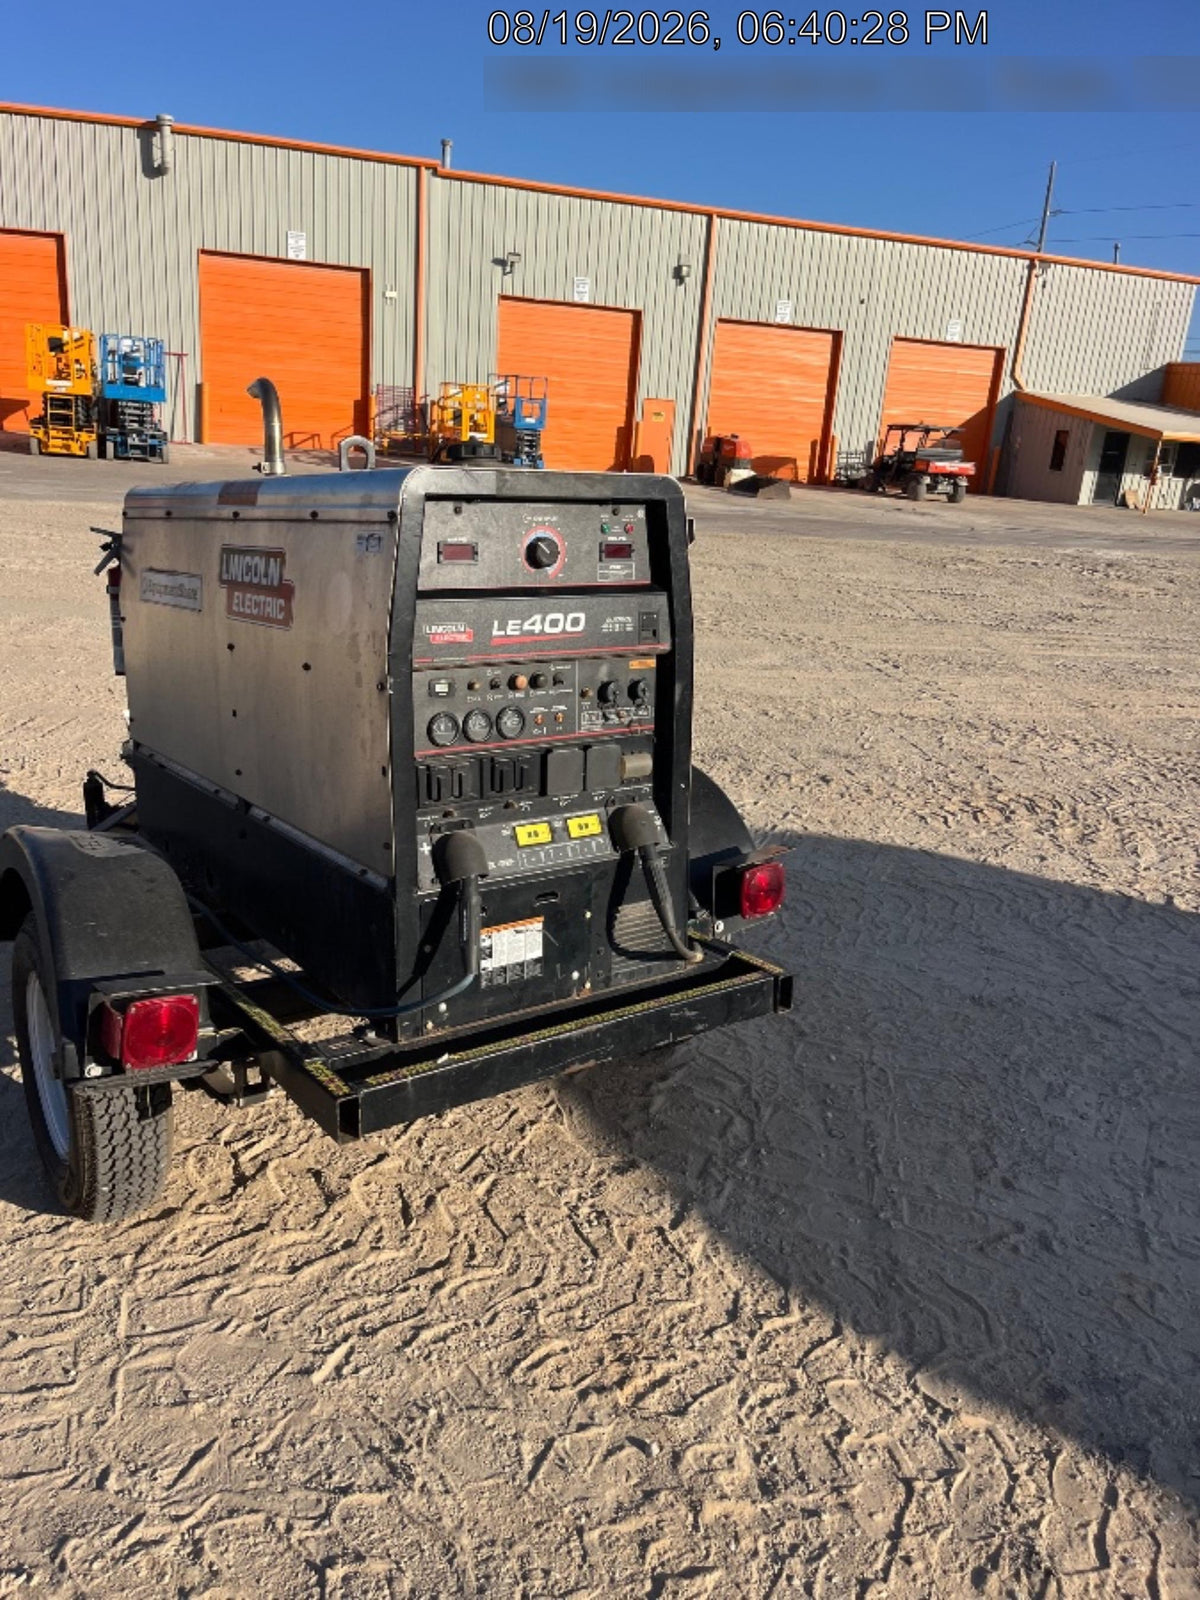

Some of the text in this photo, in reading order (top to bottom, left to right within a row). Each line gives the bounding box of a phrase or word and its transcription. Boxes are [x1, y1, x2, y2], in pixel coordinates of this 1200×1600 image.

[221, 552, 281, 588] LINCOLN
[232, 591, 286, 620] ELECTRIC
[491, 612, 586, 637] LE400
